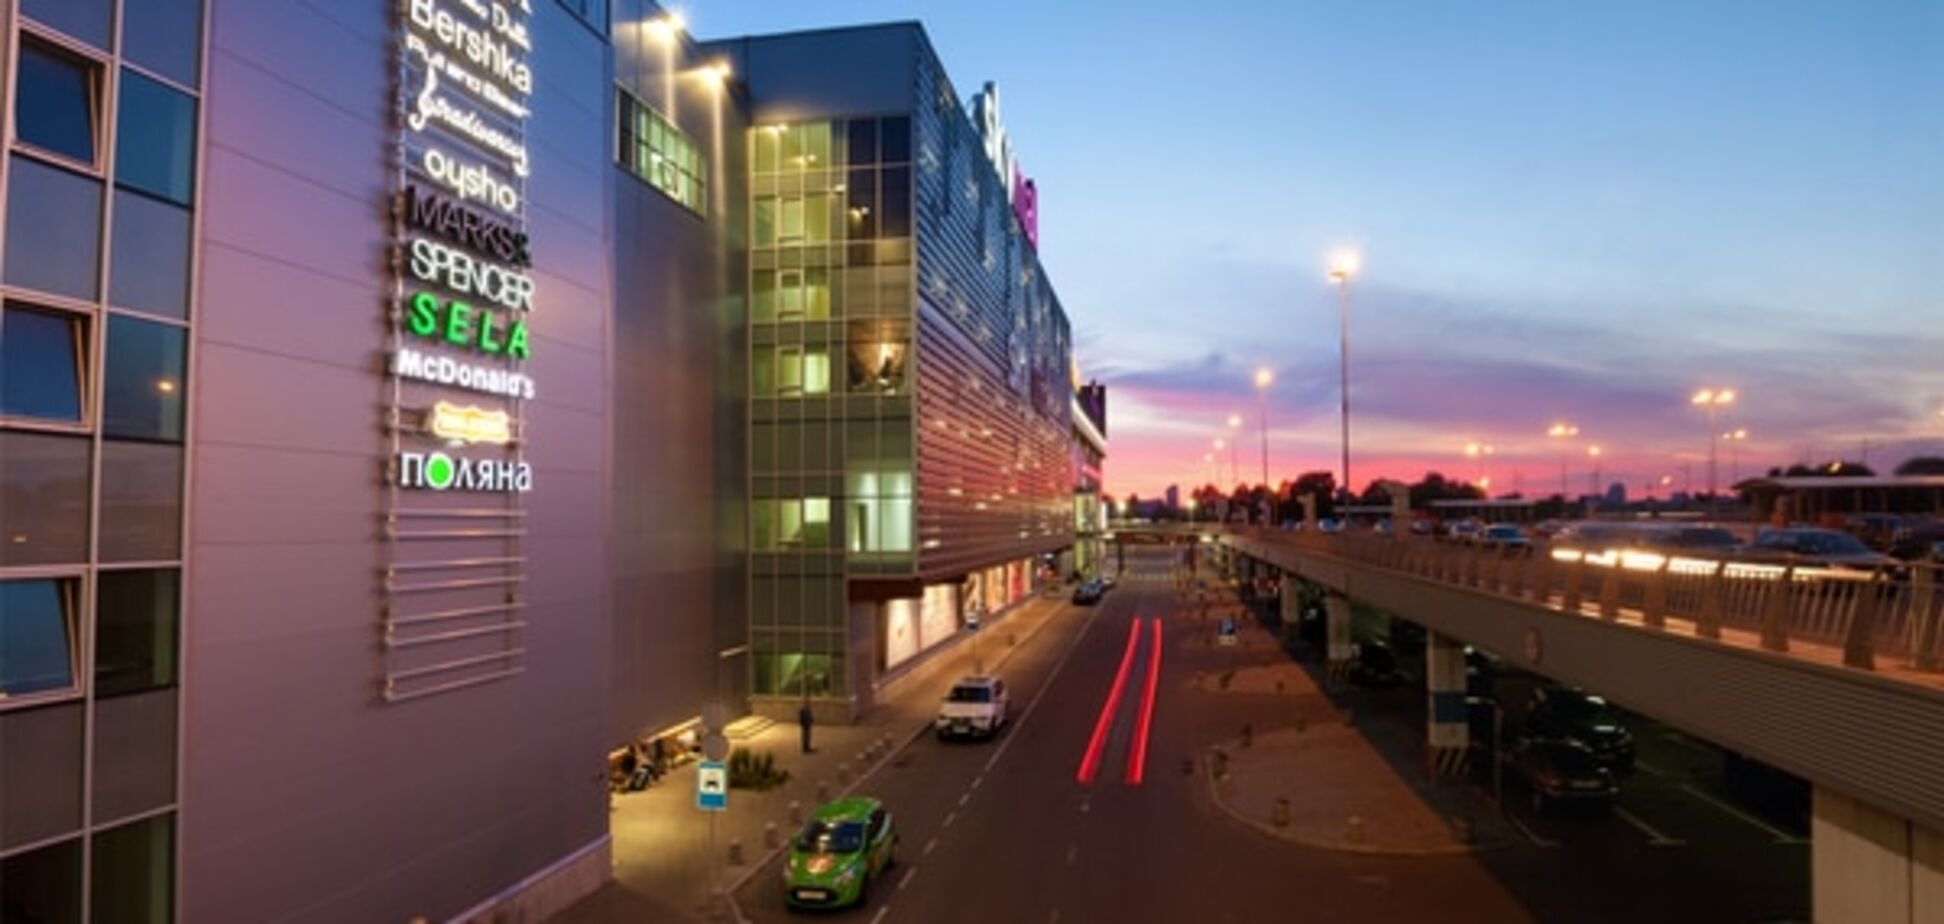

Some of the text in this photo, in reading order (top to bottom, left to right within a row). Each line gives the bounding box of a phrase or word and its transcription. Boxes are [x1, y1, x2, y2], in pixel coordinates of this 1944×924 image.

[411, 0, 533, 95] Bershka
[424, 150, 517, 211] oysho
[411, 238, 535, 312] SPENCER
[409, 292, 530, 359] SELA
[397, 349, 535, 399] McDonald's
